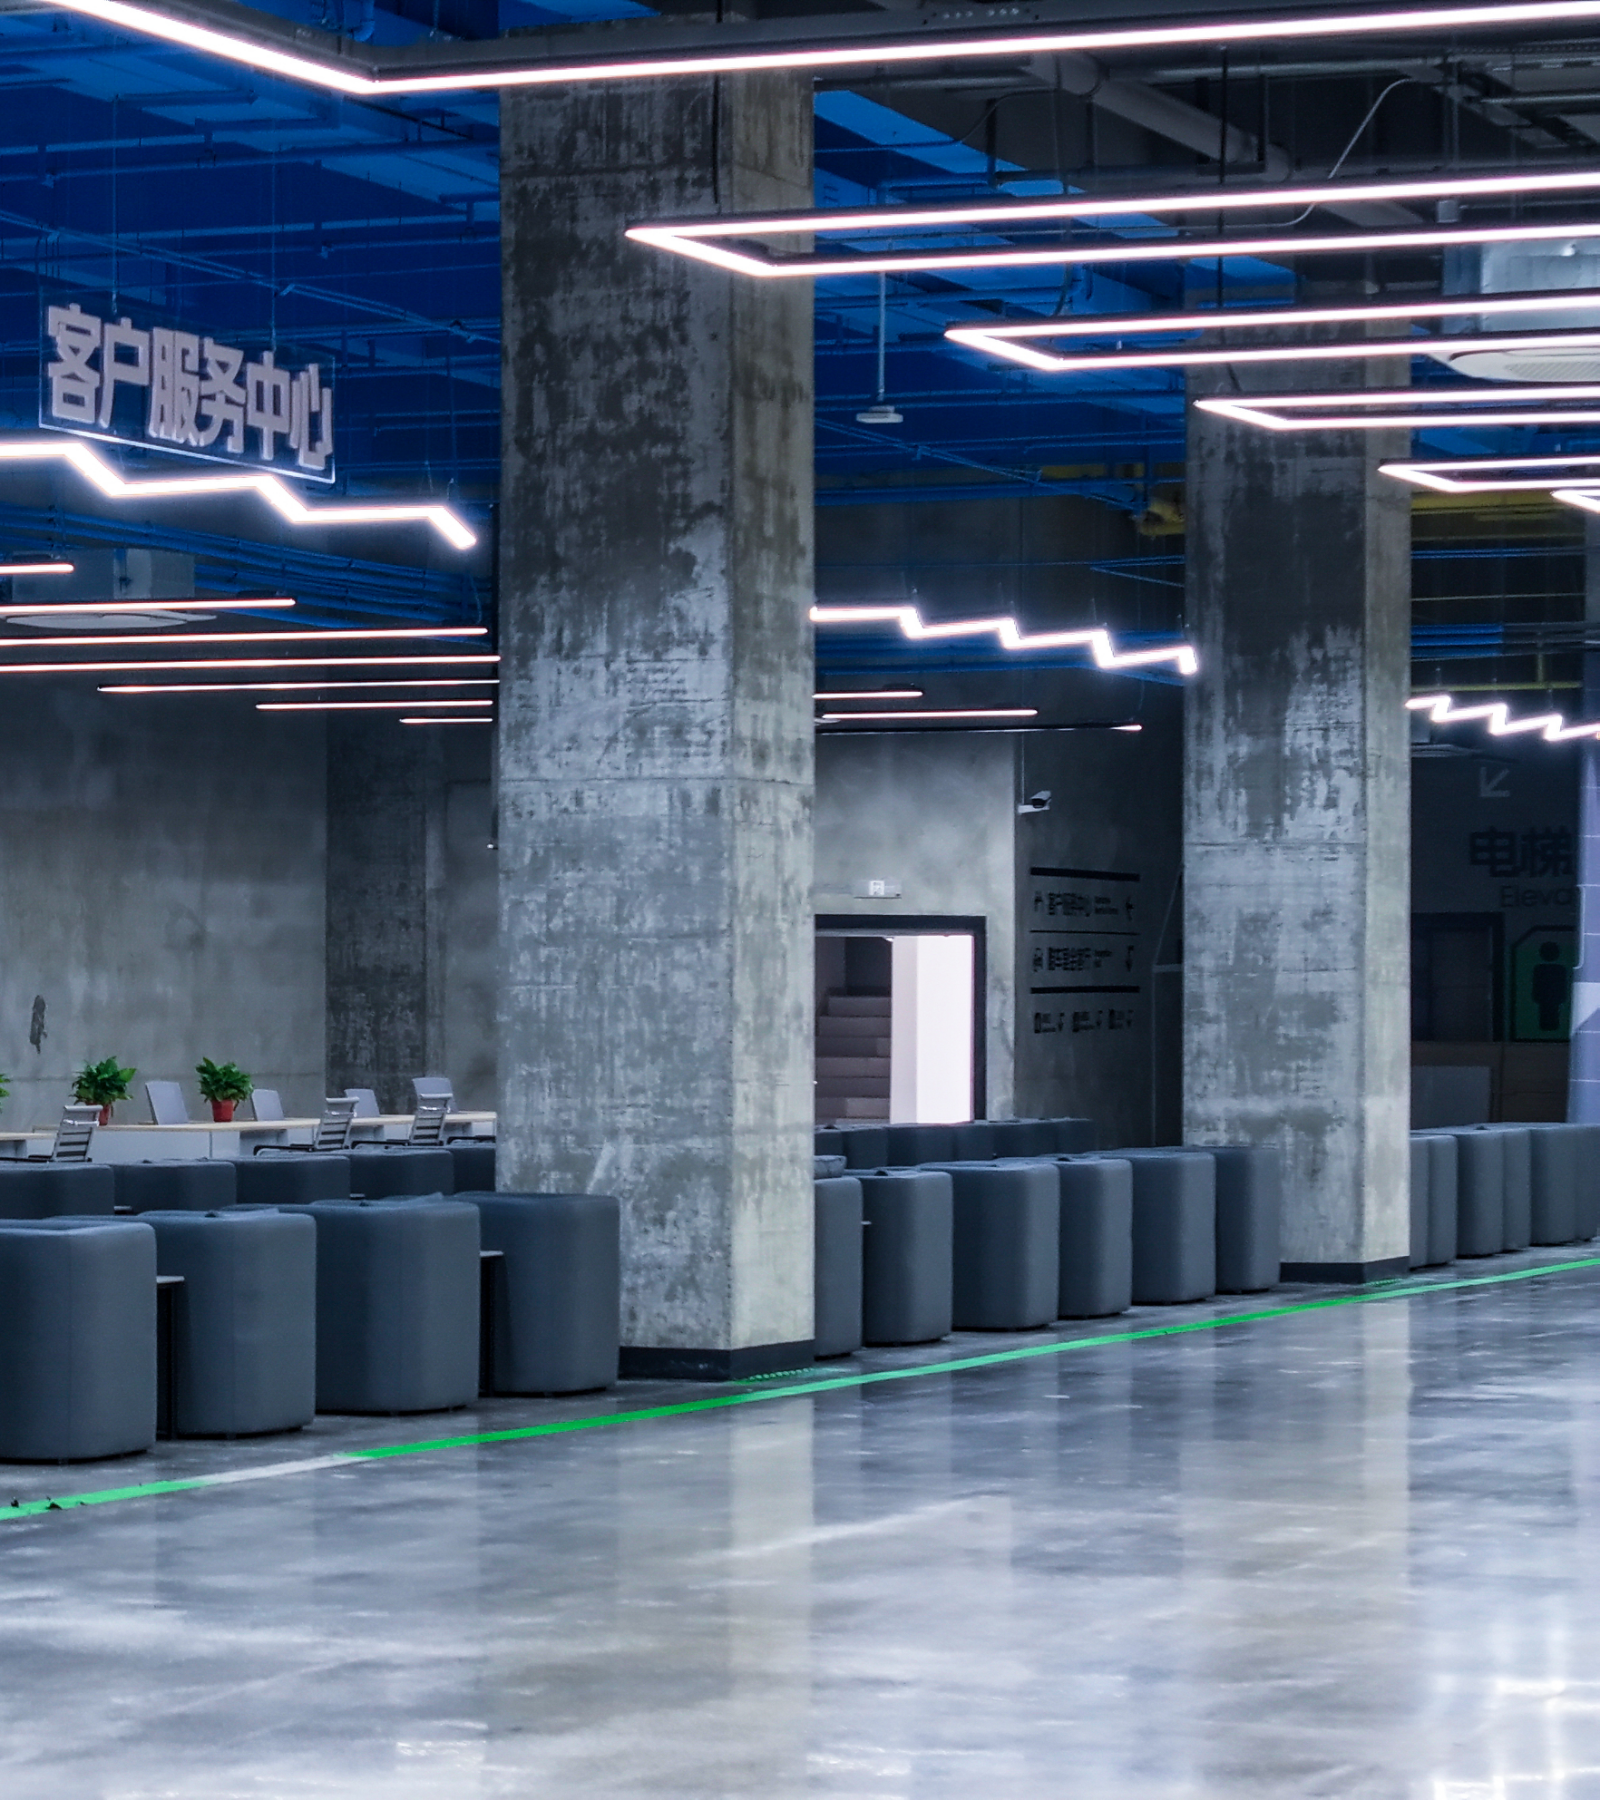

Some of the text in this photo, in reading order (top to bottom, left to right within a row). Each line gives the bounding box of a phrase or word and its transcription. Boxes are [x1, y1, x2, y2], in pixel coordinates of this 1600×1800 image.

[47, 302, 333, 471] 客户服务中心
[1469, 825, 1576, 878] 电梯
